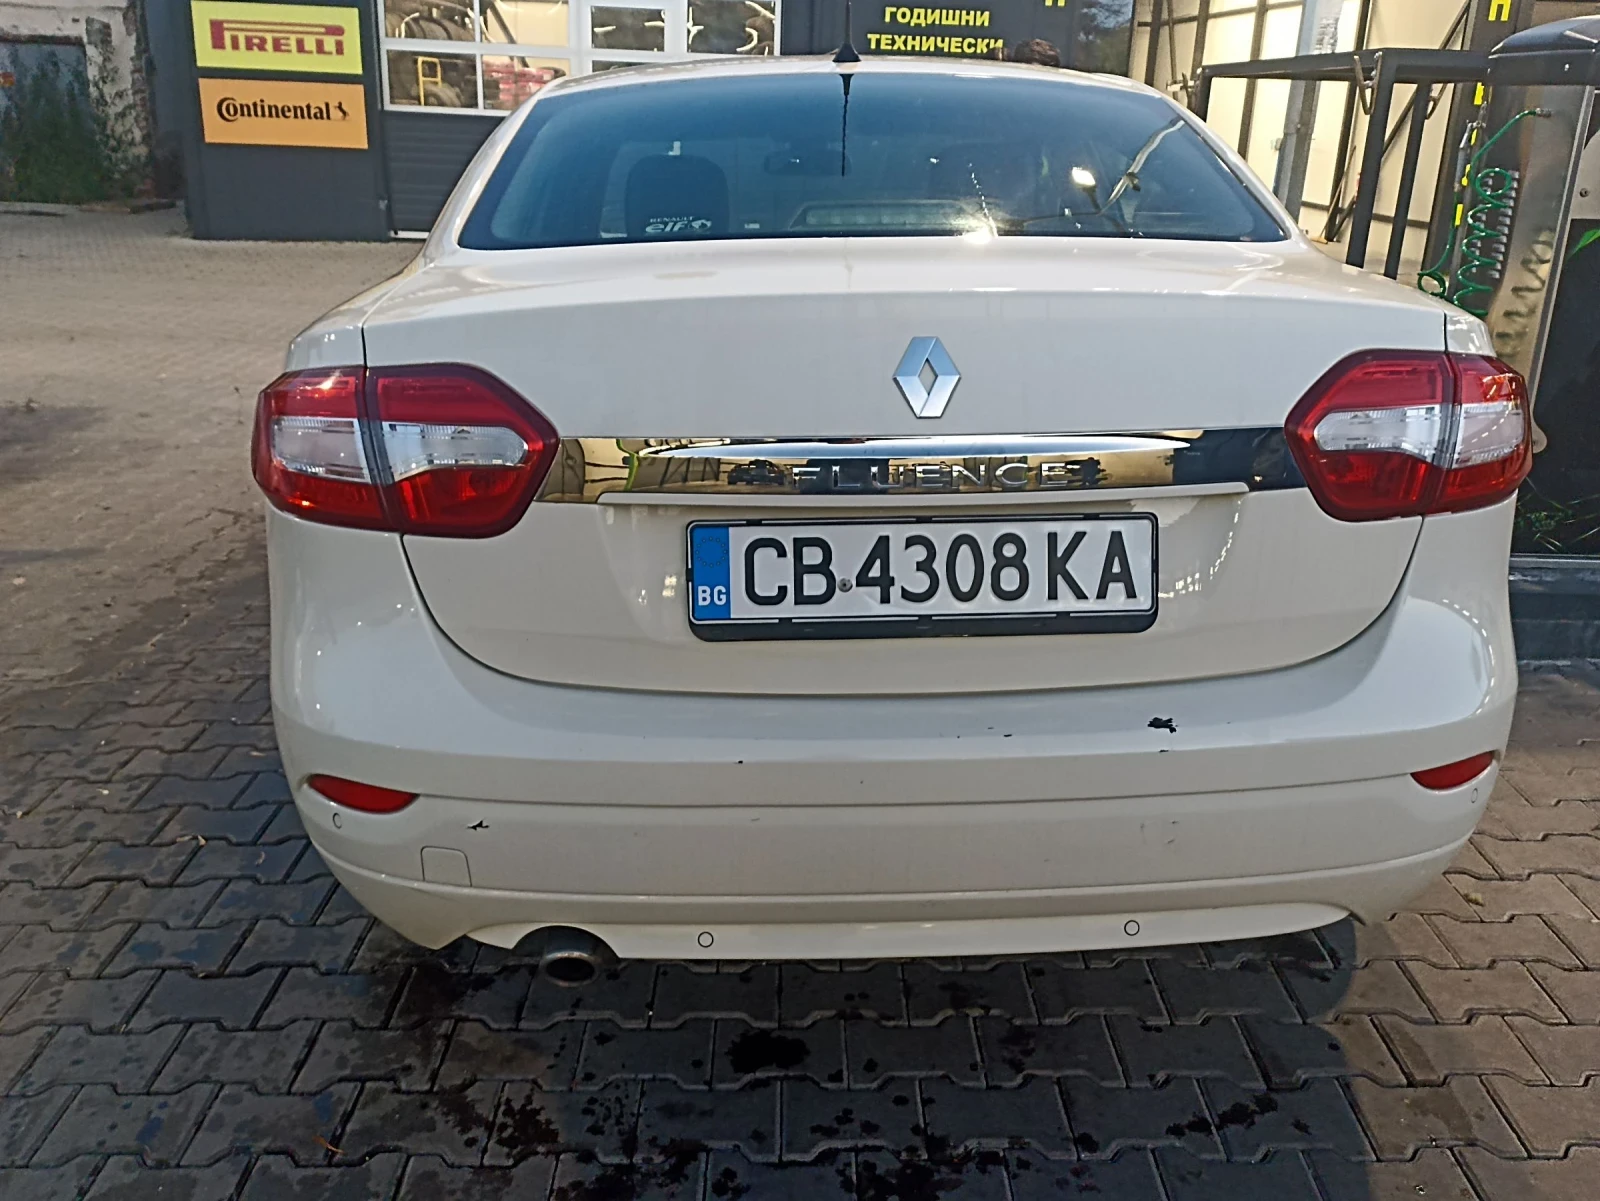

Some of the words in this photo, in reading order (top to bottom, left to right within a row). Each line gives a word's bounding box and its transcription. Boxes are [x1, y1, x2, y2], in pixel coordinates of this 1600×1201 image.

[884, 7, 989, 27] ГОДИШНИ
[209, 18, 345, 56] PIRELLI
[217, 97, 331, 122] Continental
[645, 221, 688, 232] elf
[792, 463, 1069, 488] FLUENCE
[744, 536, 837, 606] CB
[855, 532, 1030, 605] 4308
[1047, 530, 1138, 600] KA
[697, 585, 728, 606] BG
